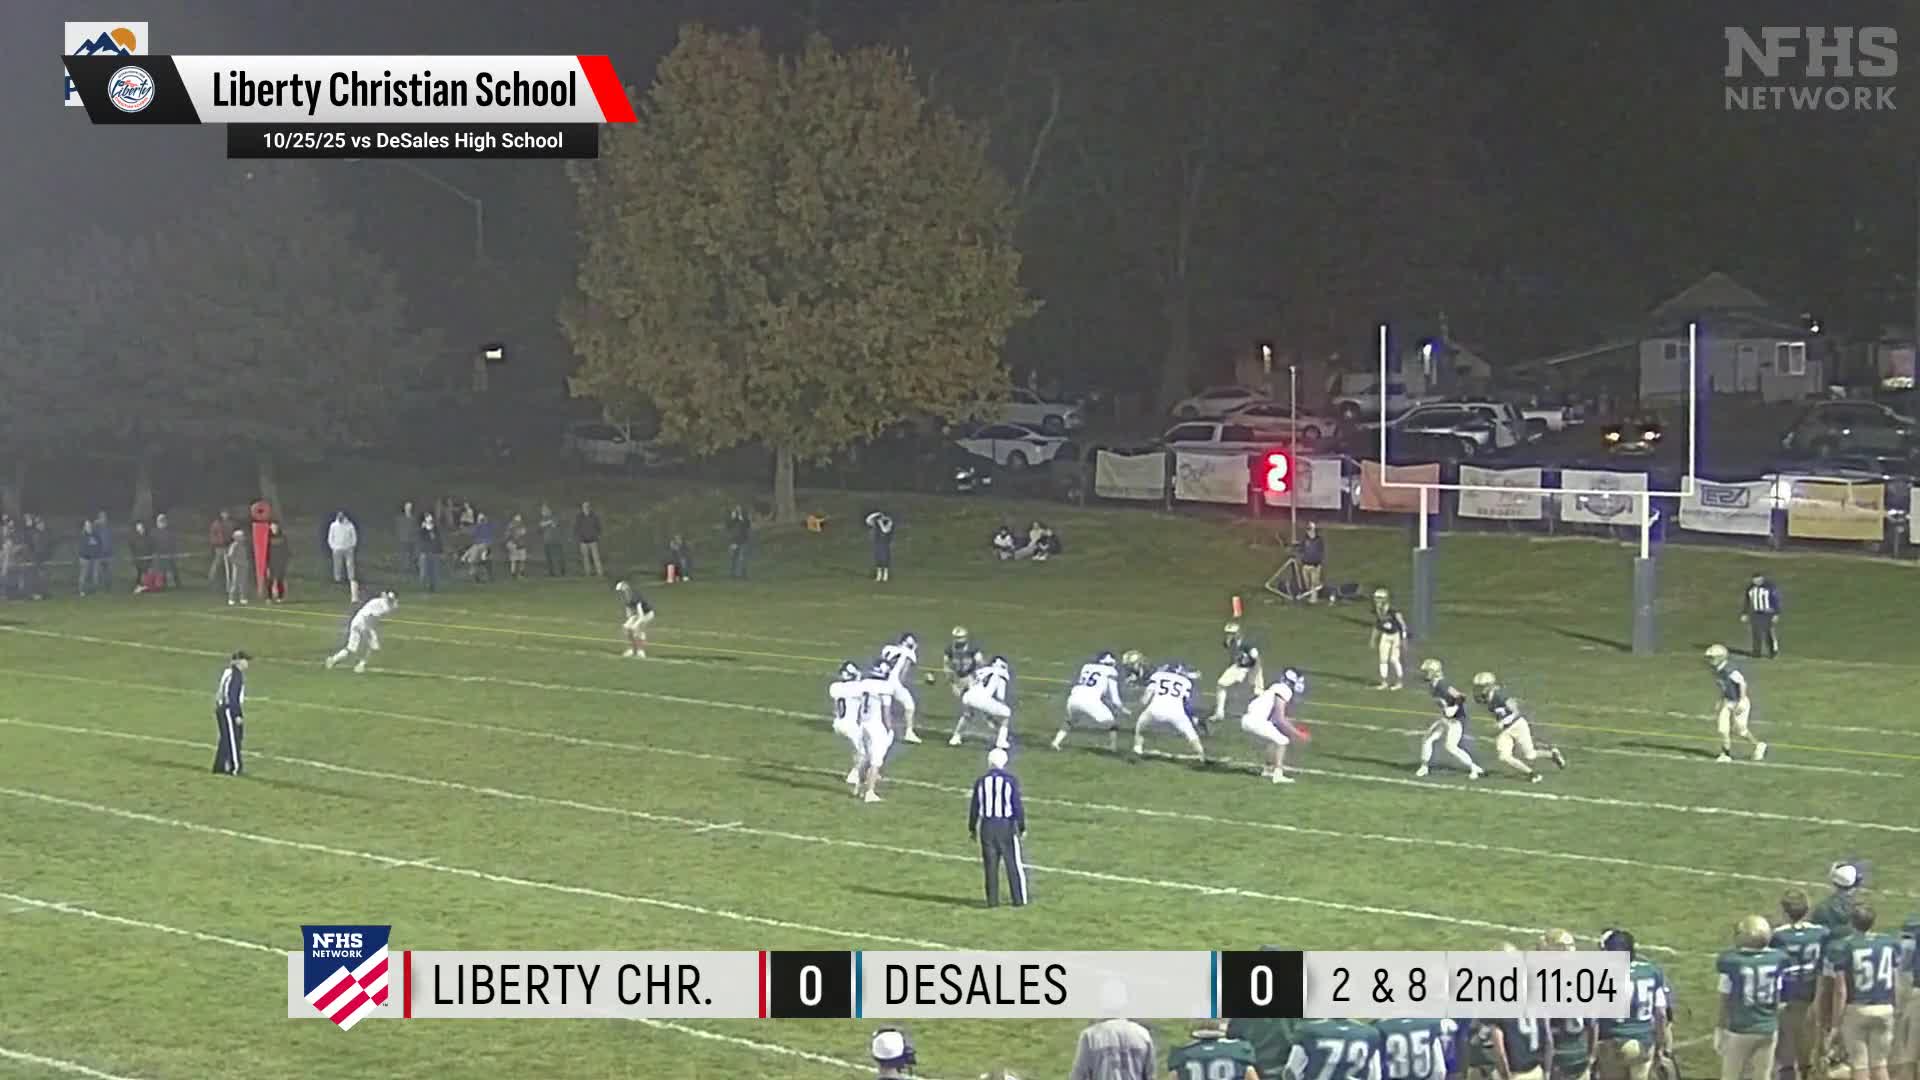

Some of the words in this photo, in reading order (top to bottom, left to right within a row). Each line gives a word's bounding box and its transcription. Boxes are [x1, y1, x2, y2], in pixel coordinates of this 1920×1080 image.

[1267, 453, 1288, 492] 2
[1158, 679, 1184, 698] 55
[1740, 965, 1777, 1006] 15
[1852, 945, 1893, 992] 54
[1630, 978, 1656, 1021] 5
[1314, 1039, 1369, 1080] 72
[1385, 1029, 1431, 1079] 35
